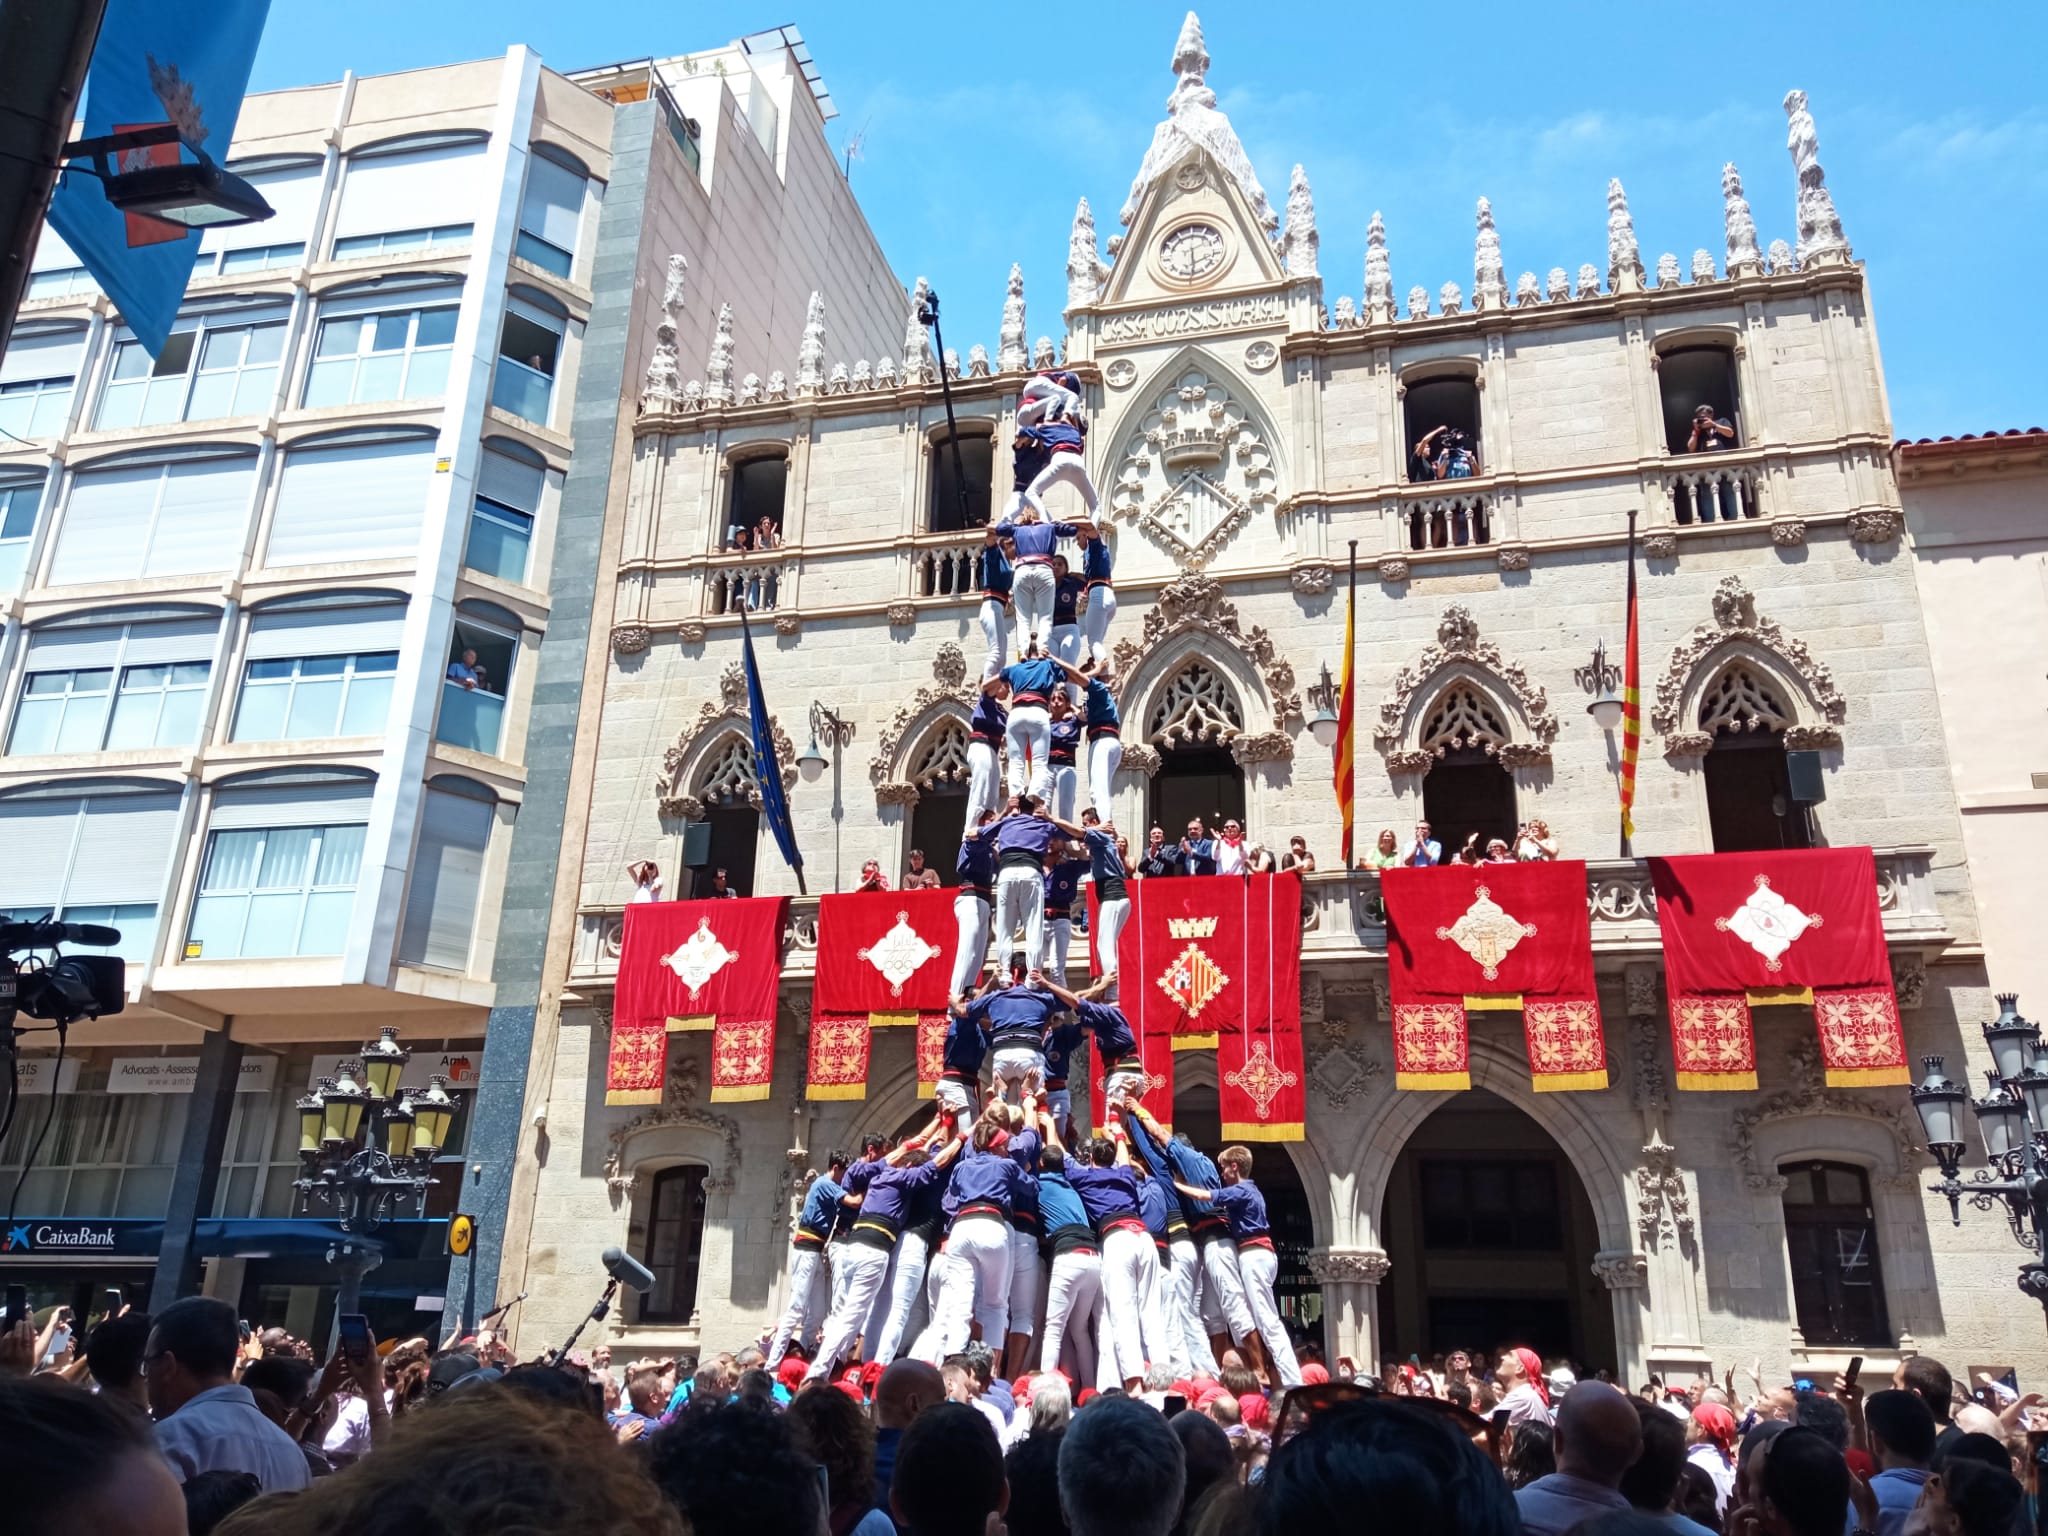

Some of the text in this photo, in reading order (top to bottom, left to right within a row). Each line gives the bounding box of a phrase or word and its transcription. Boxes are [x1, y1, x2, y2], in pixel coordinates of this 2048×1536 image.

[1101, 313, 1148, 343] CASA
[440, 1055, 469, 1066] Amb
[17, 1062, 38, 1075] ats
[121, 1064, 160, 1075] Advocats
[165, 1063, 199, 1074] Assesso
[460, 1070, 480, 1082] Dre
[36, 1225, 116, 1245] CaixaBank
